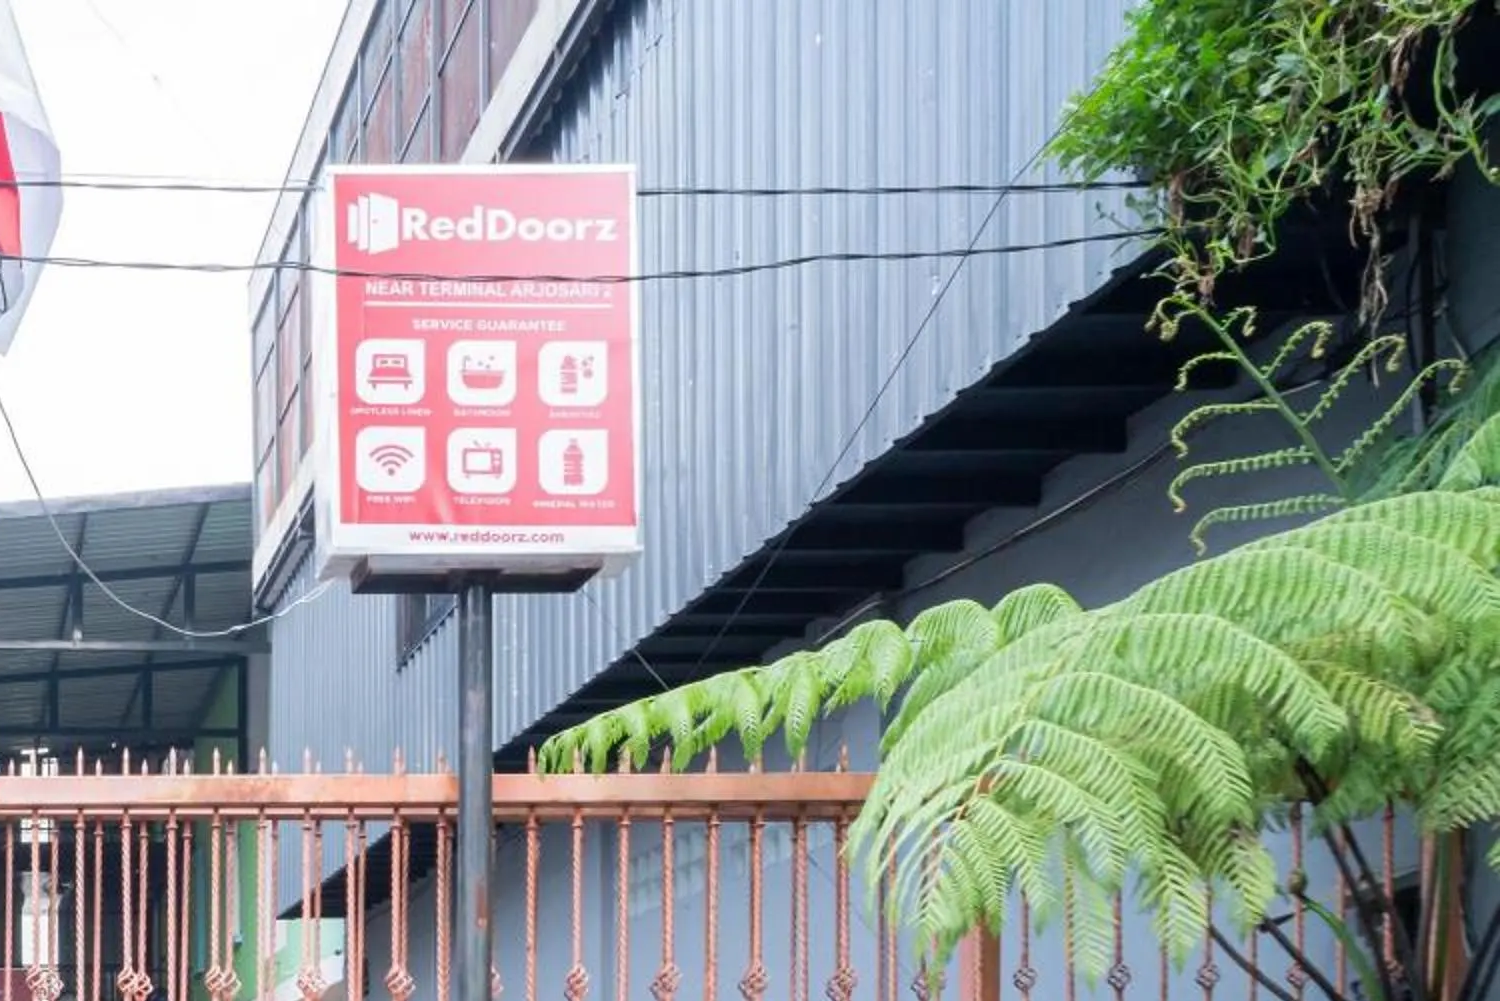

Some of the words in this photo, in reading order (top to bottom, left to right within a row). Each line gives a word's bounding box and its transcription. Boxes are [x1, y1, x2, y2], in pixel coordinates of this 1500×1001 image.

[403, 205, 618, 243] RedDoorz
[365, 280, 414, 297] NEAR
[420, 281, 507, 297] TERMINAL
[412, 319, 472, 332] SERVICE
[476, 320, 566, 332] GUARANTEE
[409, 529, 565, 544] www.reddoorz.com
